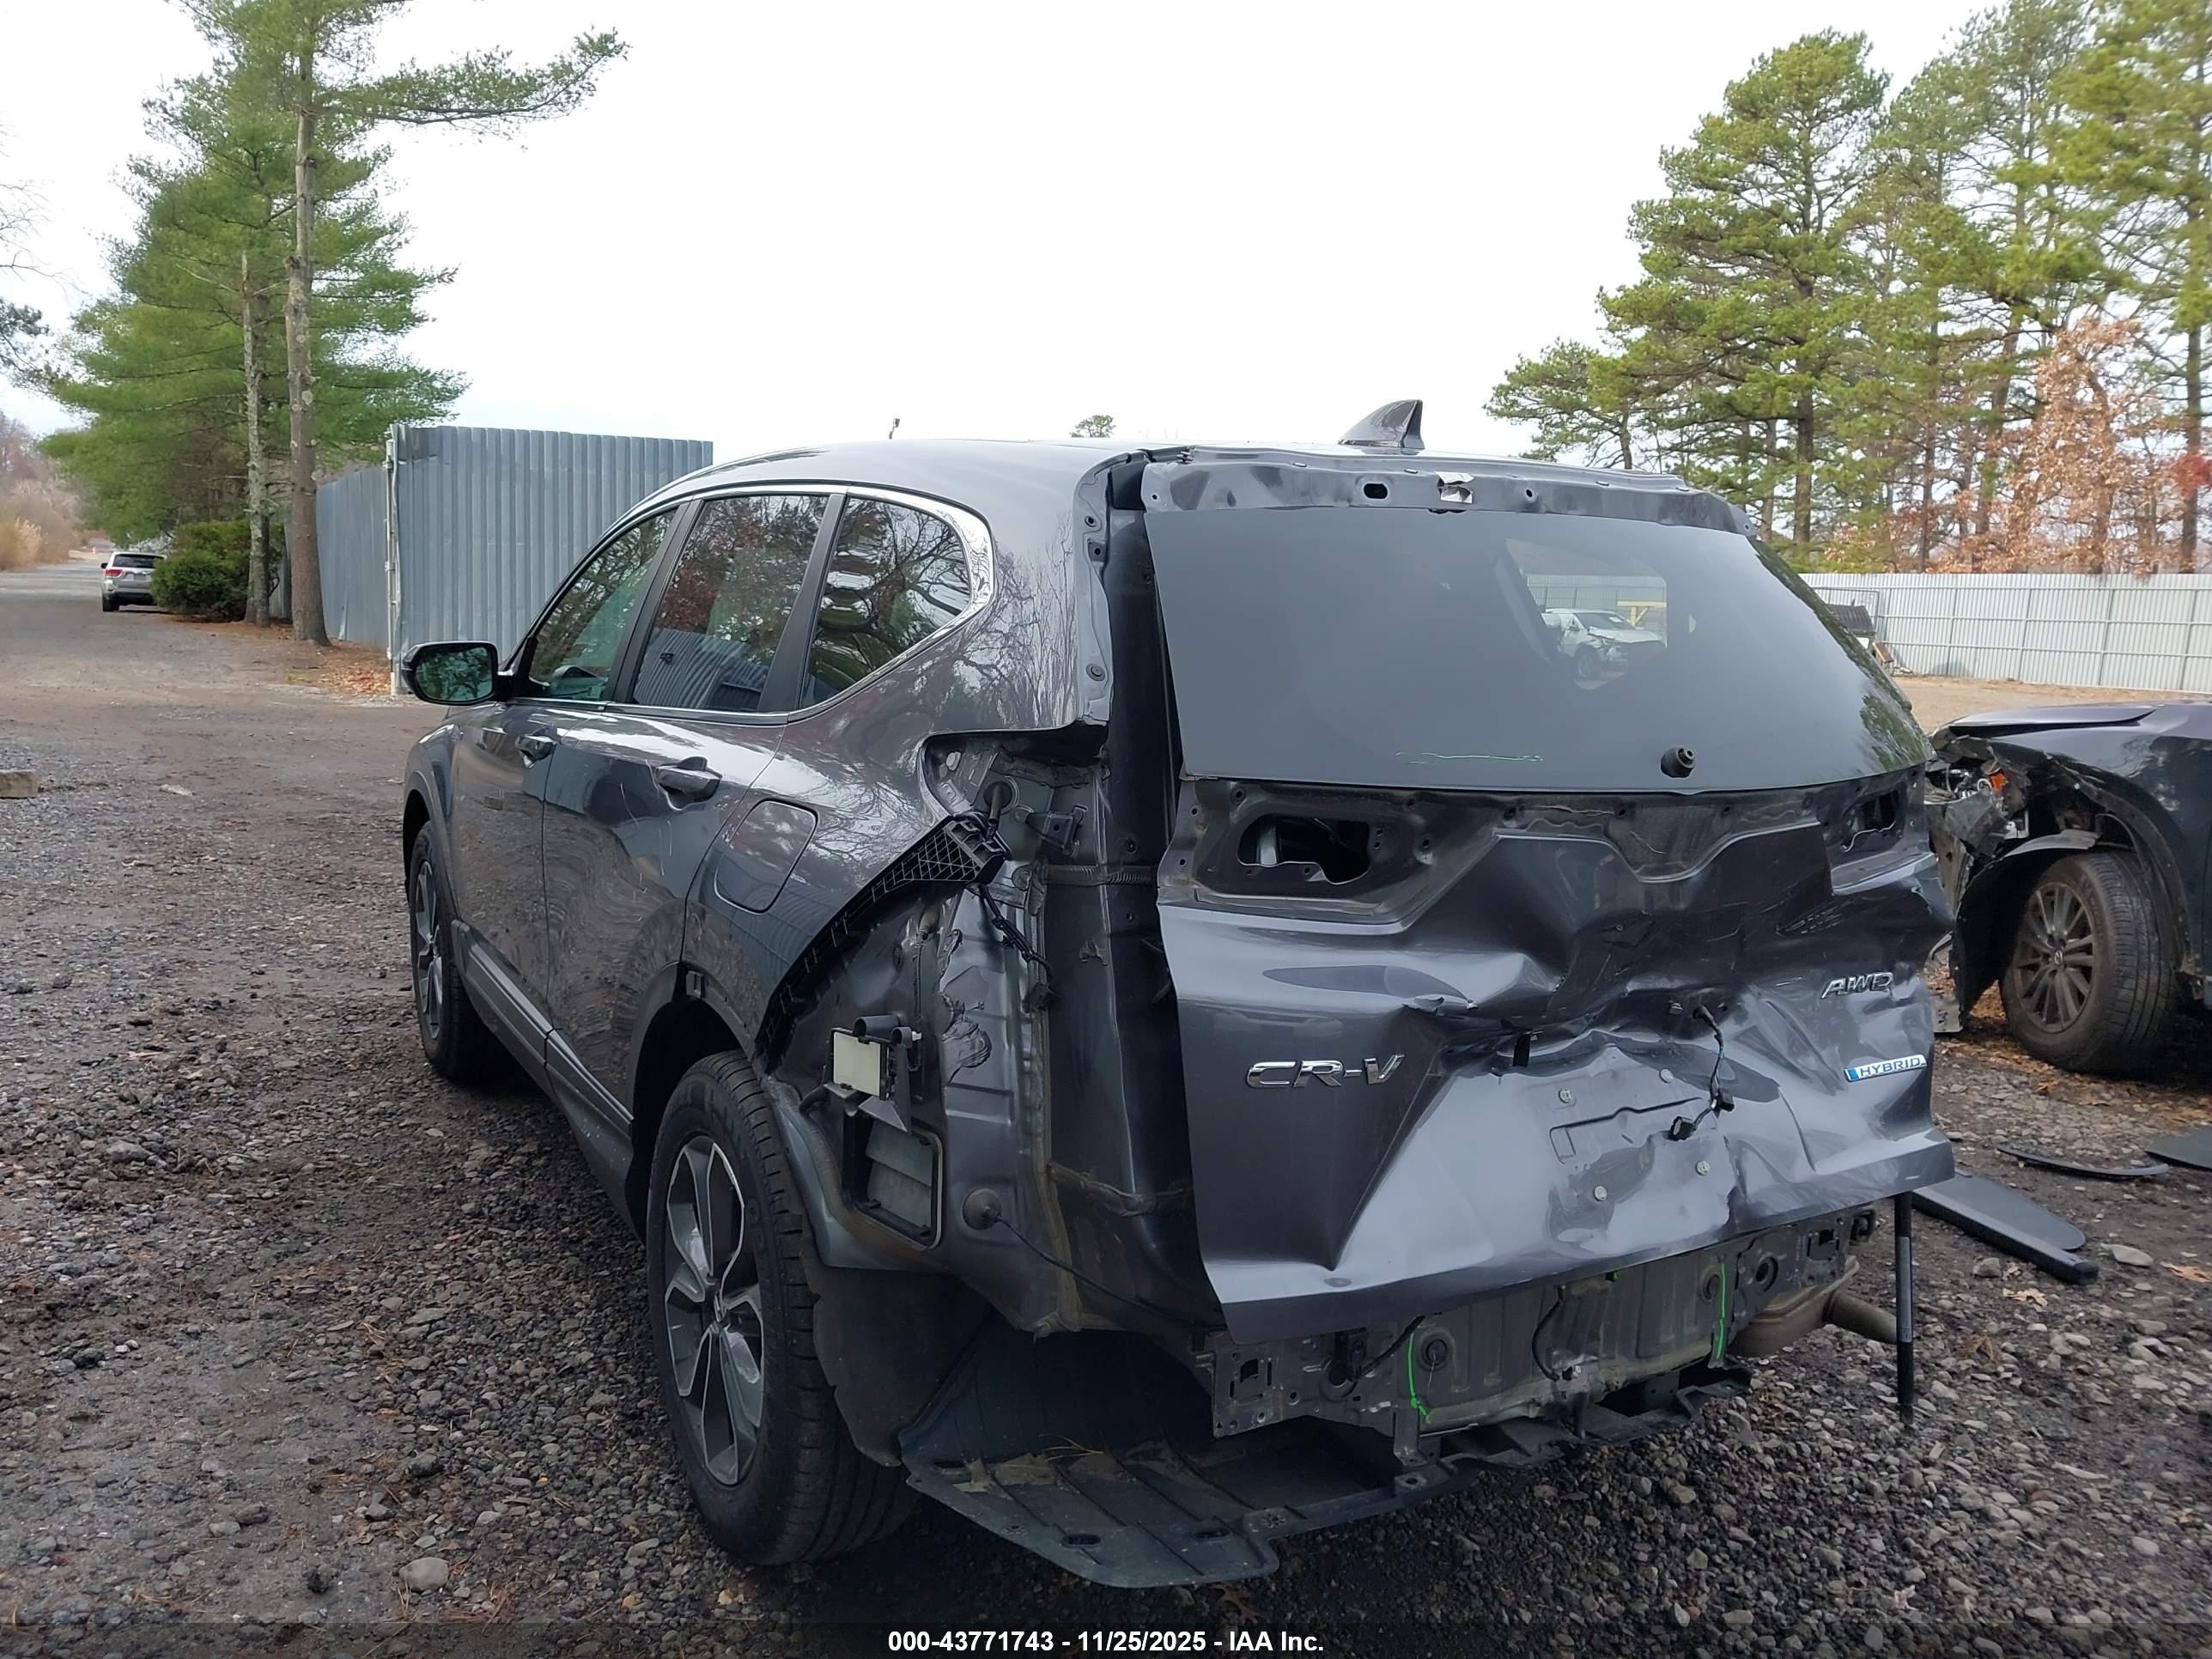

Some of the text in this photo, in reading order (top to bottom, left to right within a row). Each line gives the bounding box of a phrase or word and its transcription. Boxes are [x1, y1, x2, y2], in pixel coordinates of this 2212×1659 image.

[1820, 971, 1893, 999] AWD
[1247, 1053, 1406, 1088] CR-V
[1860, 1057, 1922, 1077] HYBRID
